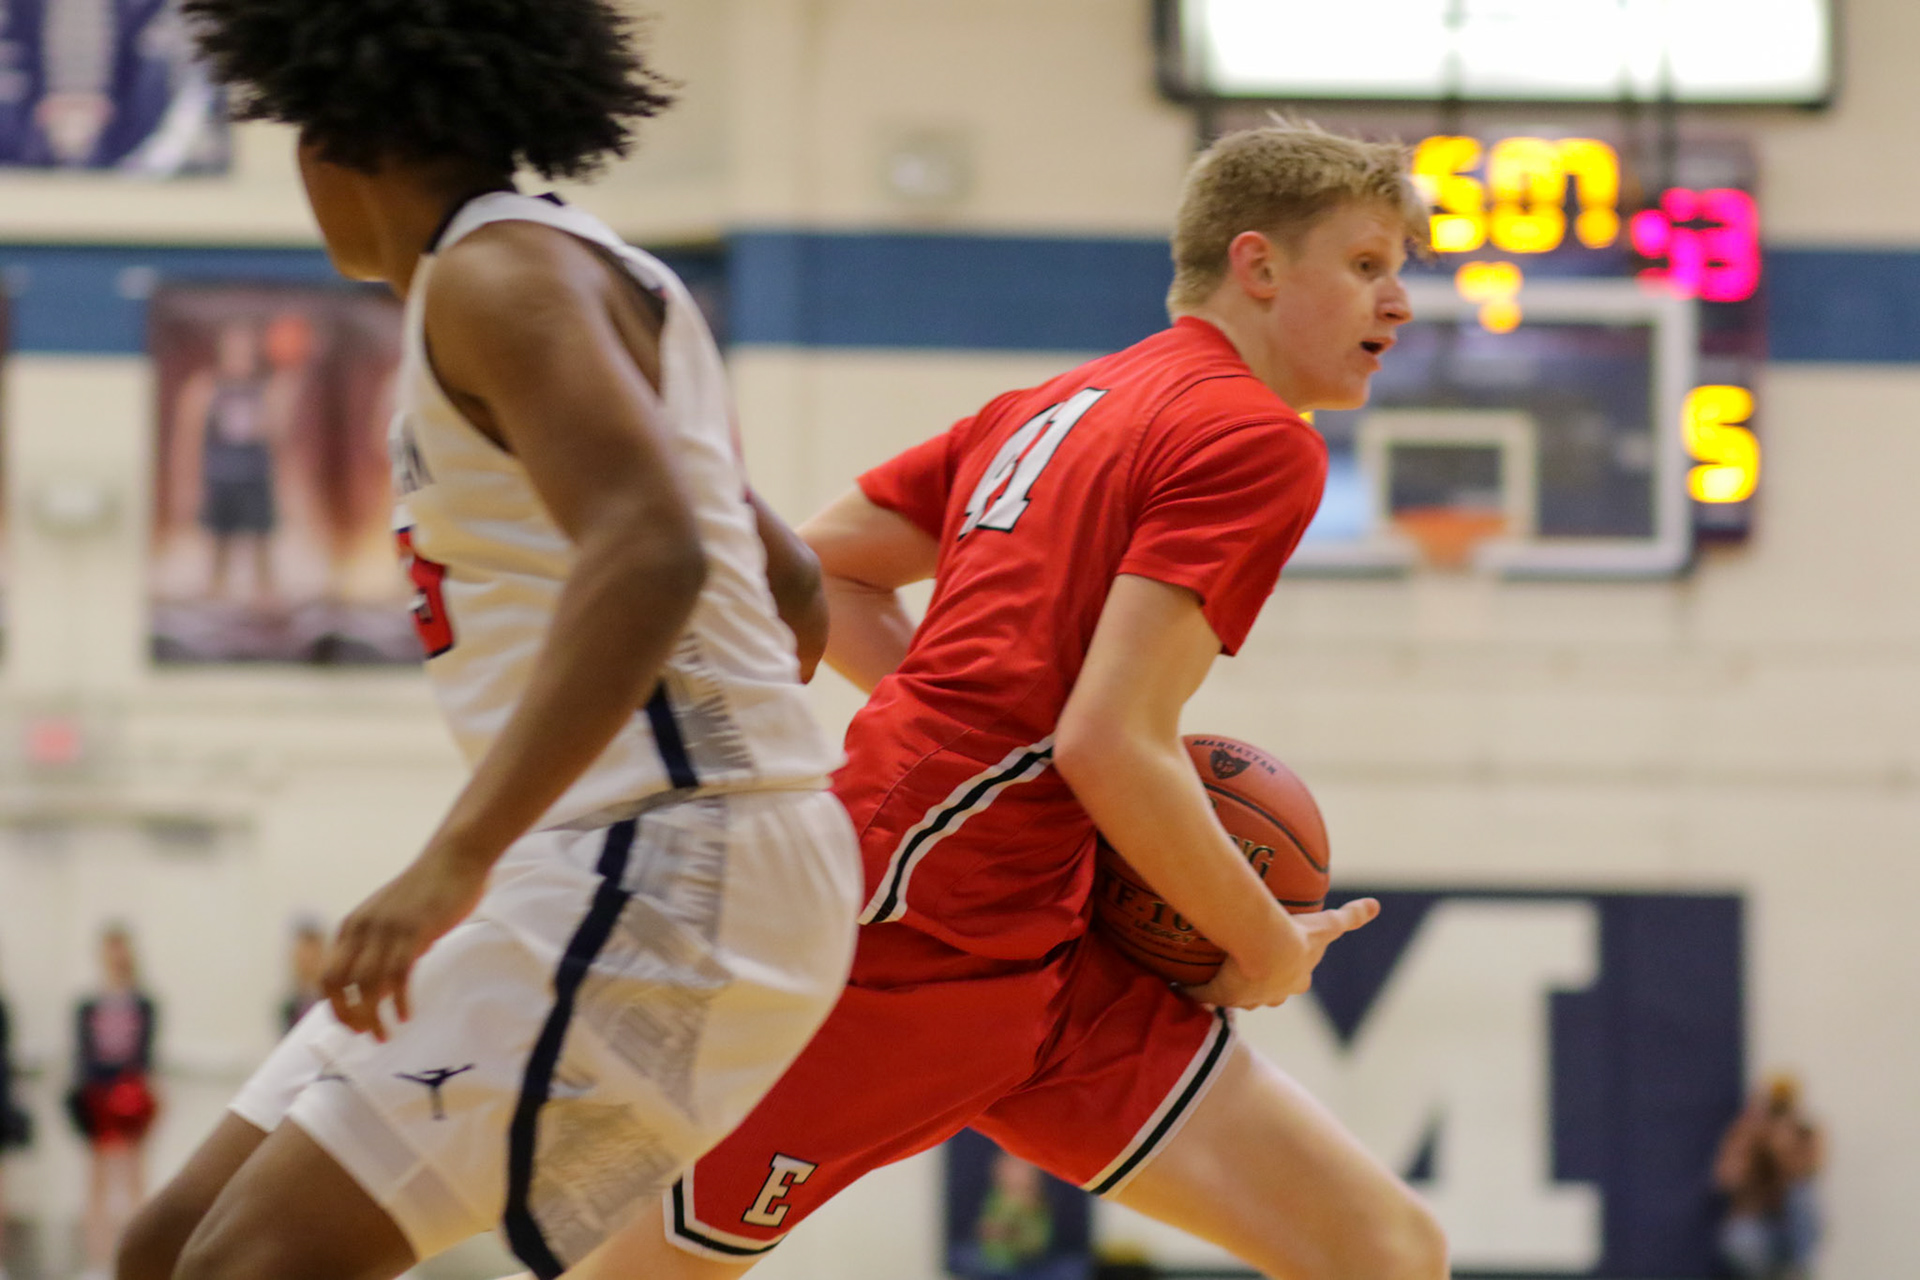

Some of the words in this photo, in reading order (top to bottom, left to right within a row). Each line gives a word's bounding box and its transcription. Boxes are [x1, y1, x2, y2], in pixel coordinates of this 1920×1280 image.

[957, 386, 1110, 542] 41
[1682, 384, 1760, 504] 5
[1192, 738, 1278, 775] MANHATTAN
[741, 1151, 819, 1228] E
